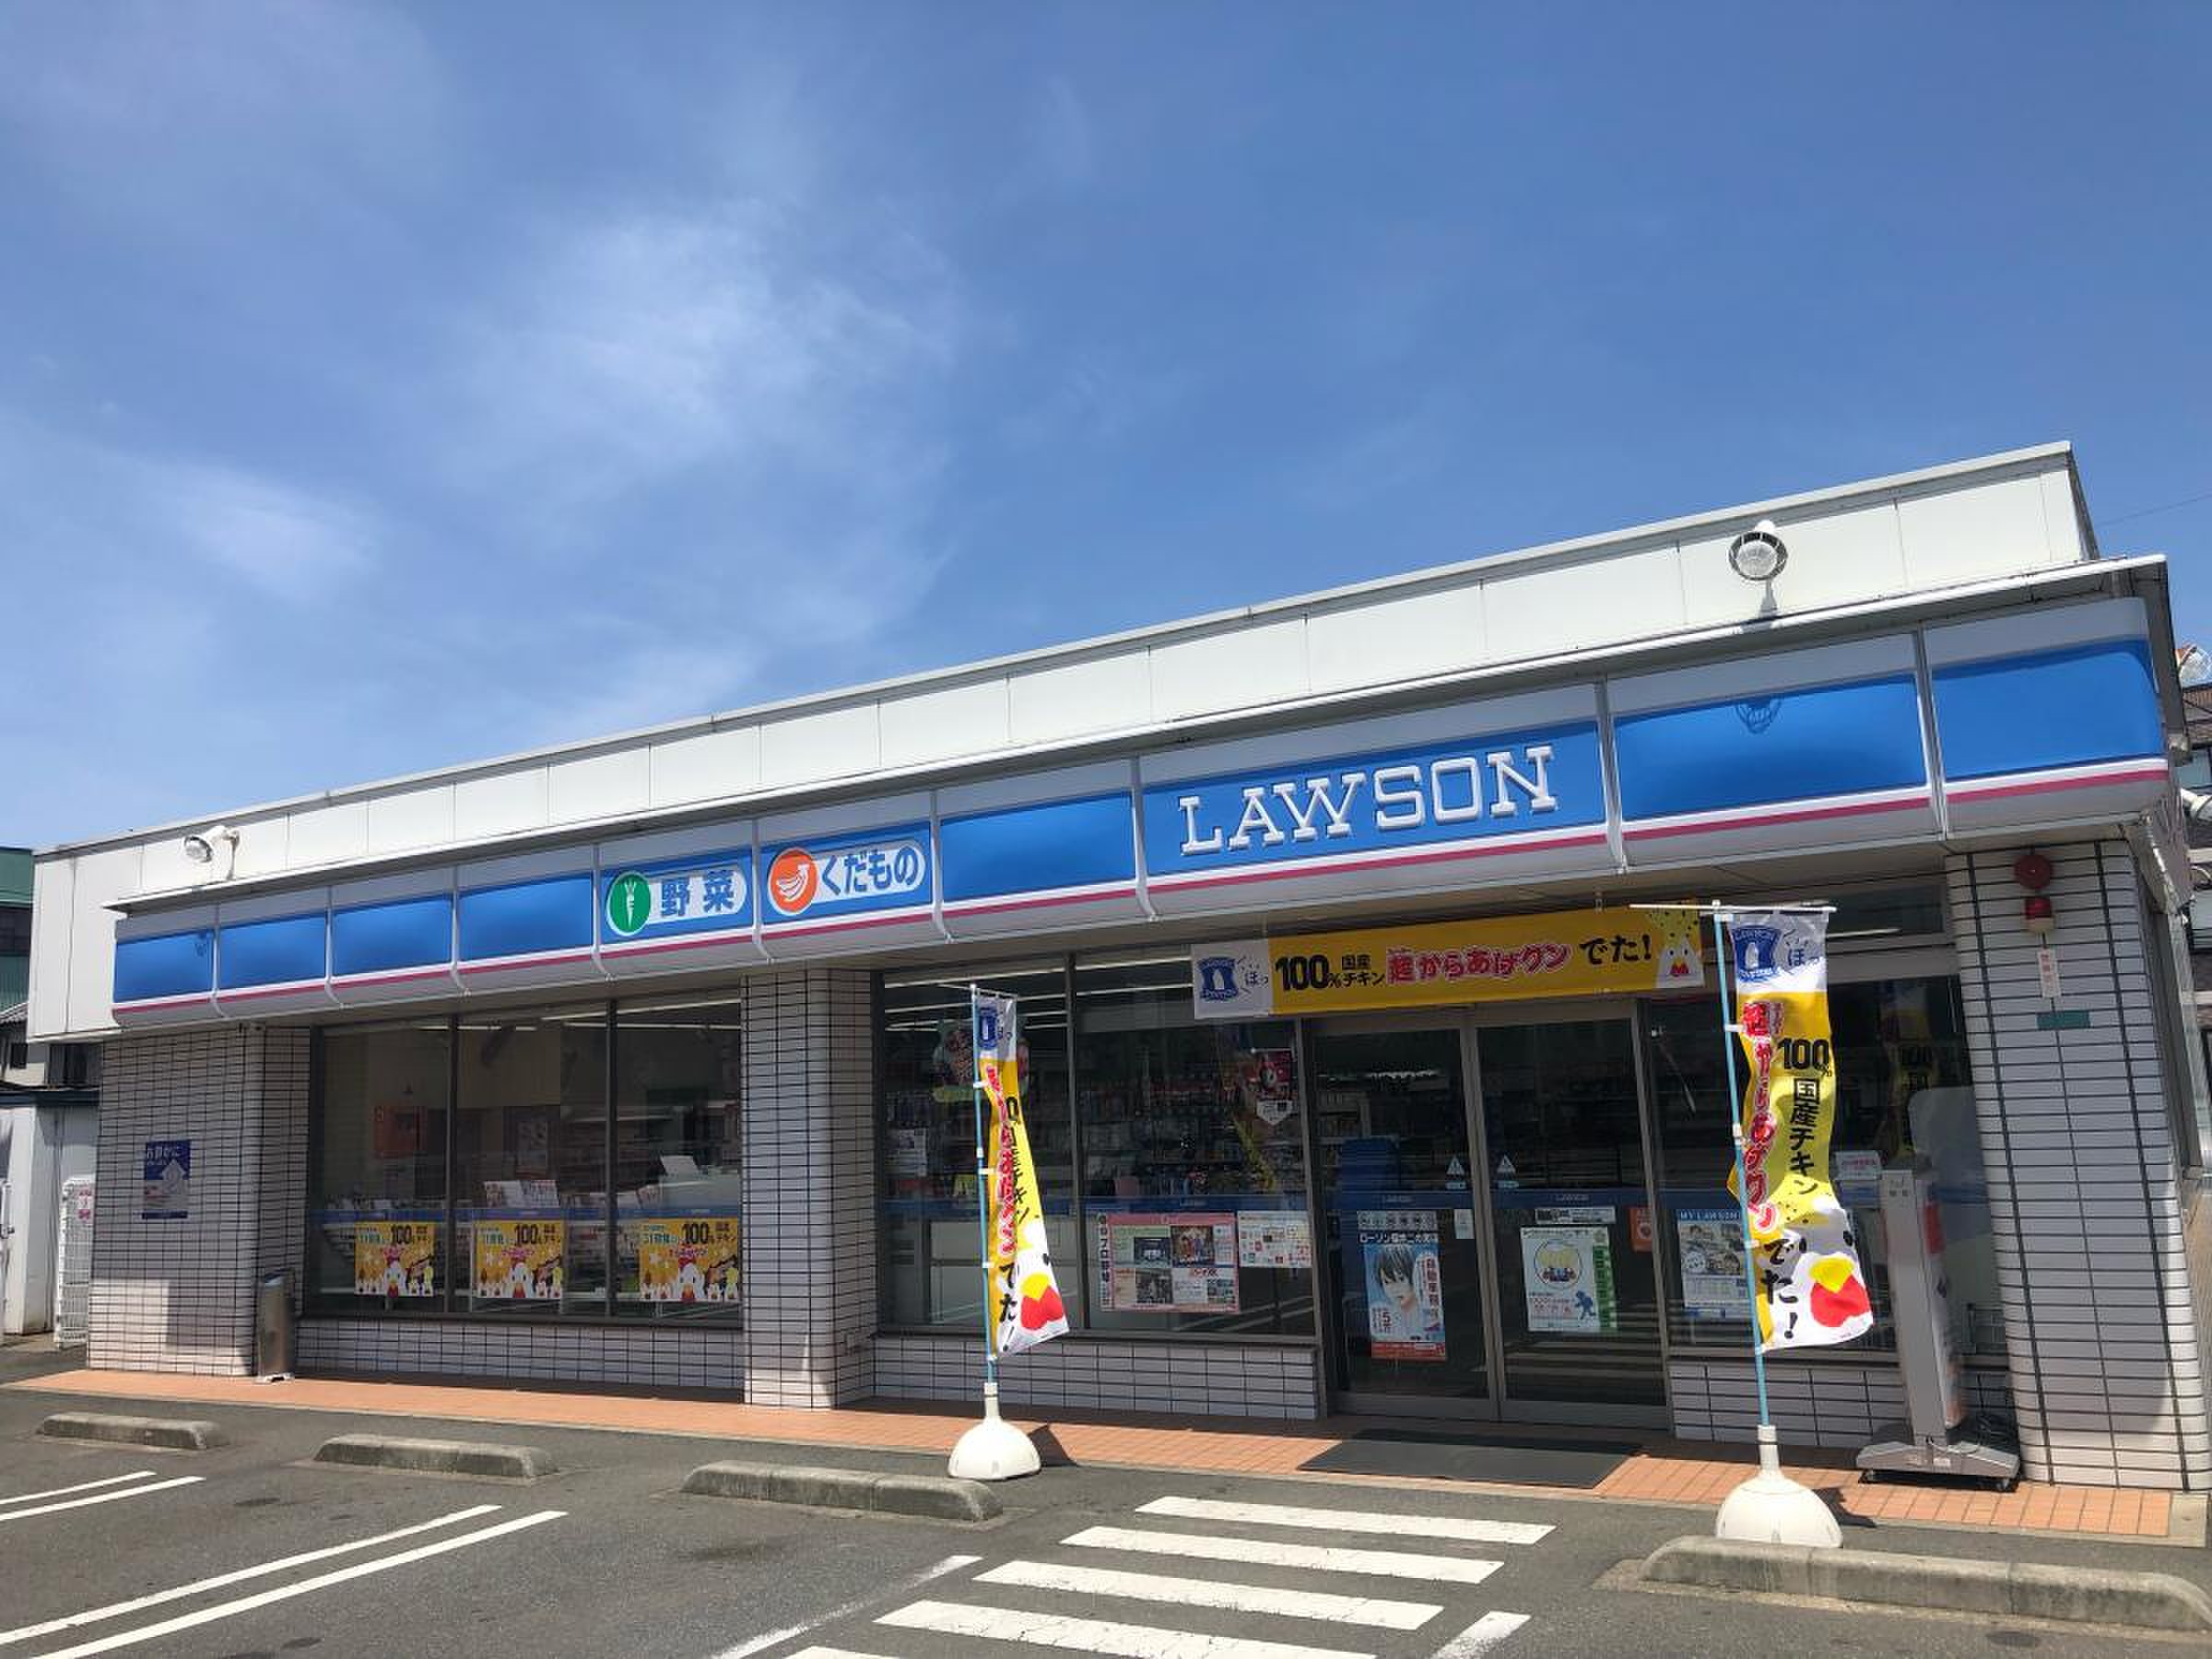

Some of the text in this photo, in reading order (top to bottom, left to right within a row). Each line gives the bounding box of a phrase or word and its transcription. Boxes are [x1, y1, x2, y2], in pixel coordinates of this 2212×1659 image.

[1179, 745, 1558, 857] LAWSON
[660, 870, 735, 918] 野菜
[820, 845, 920, 897] くだもの
[1789, 1077, 1821, 1195] 国産チキン
